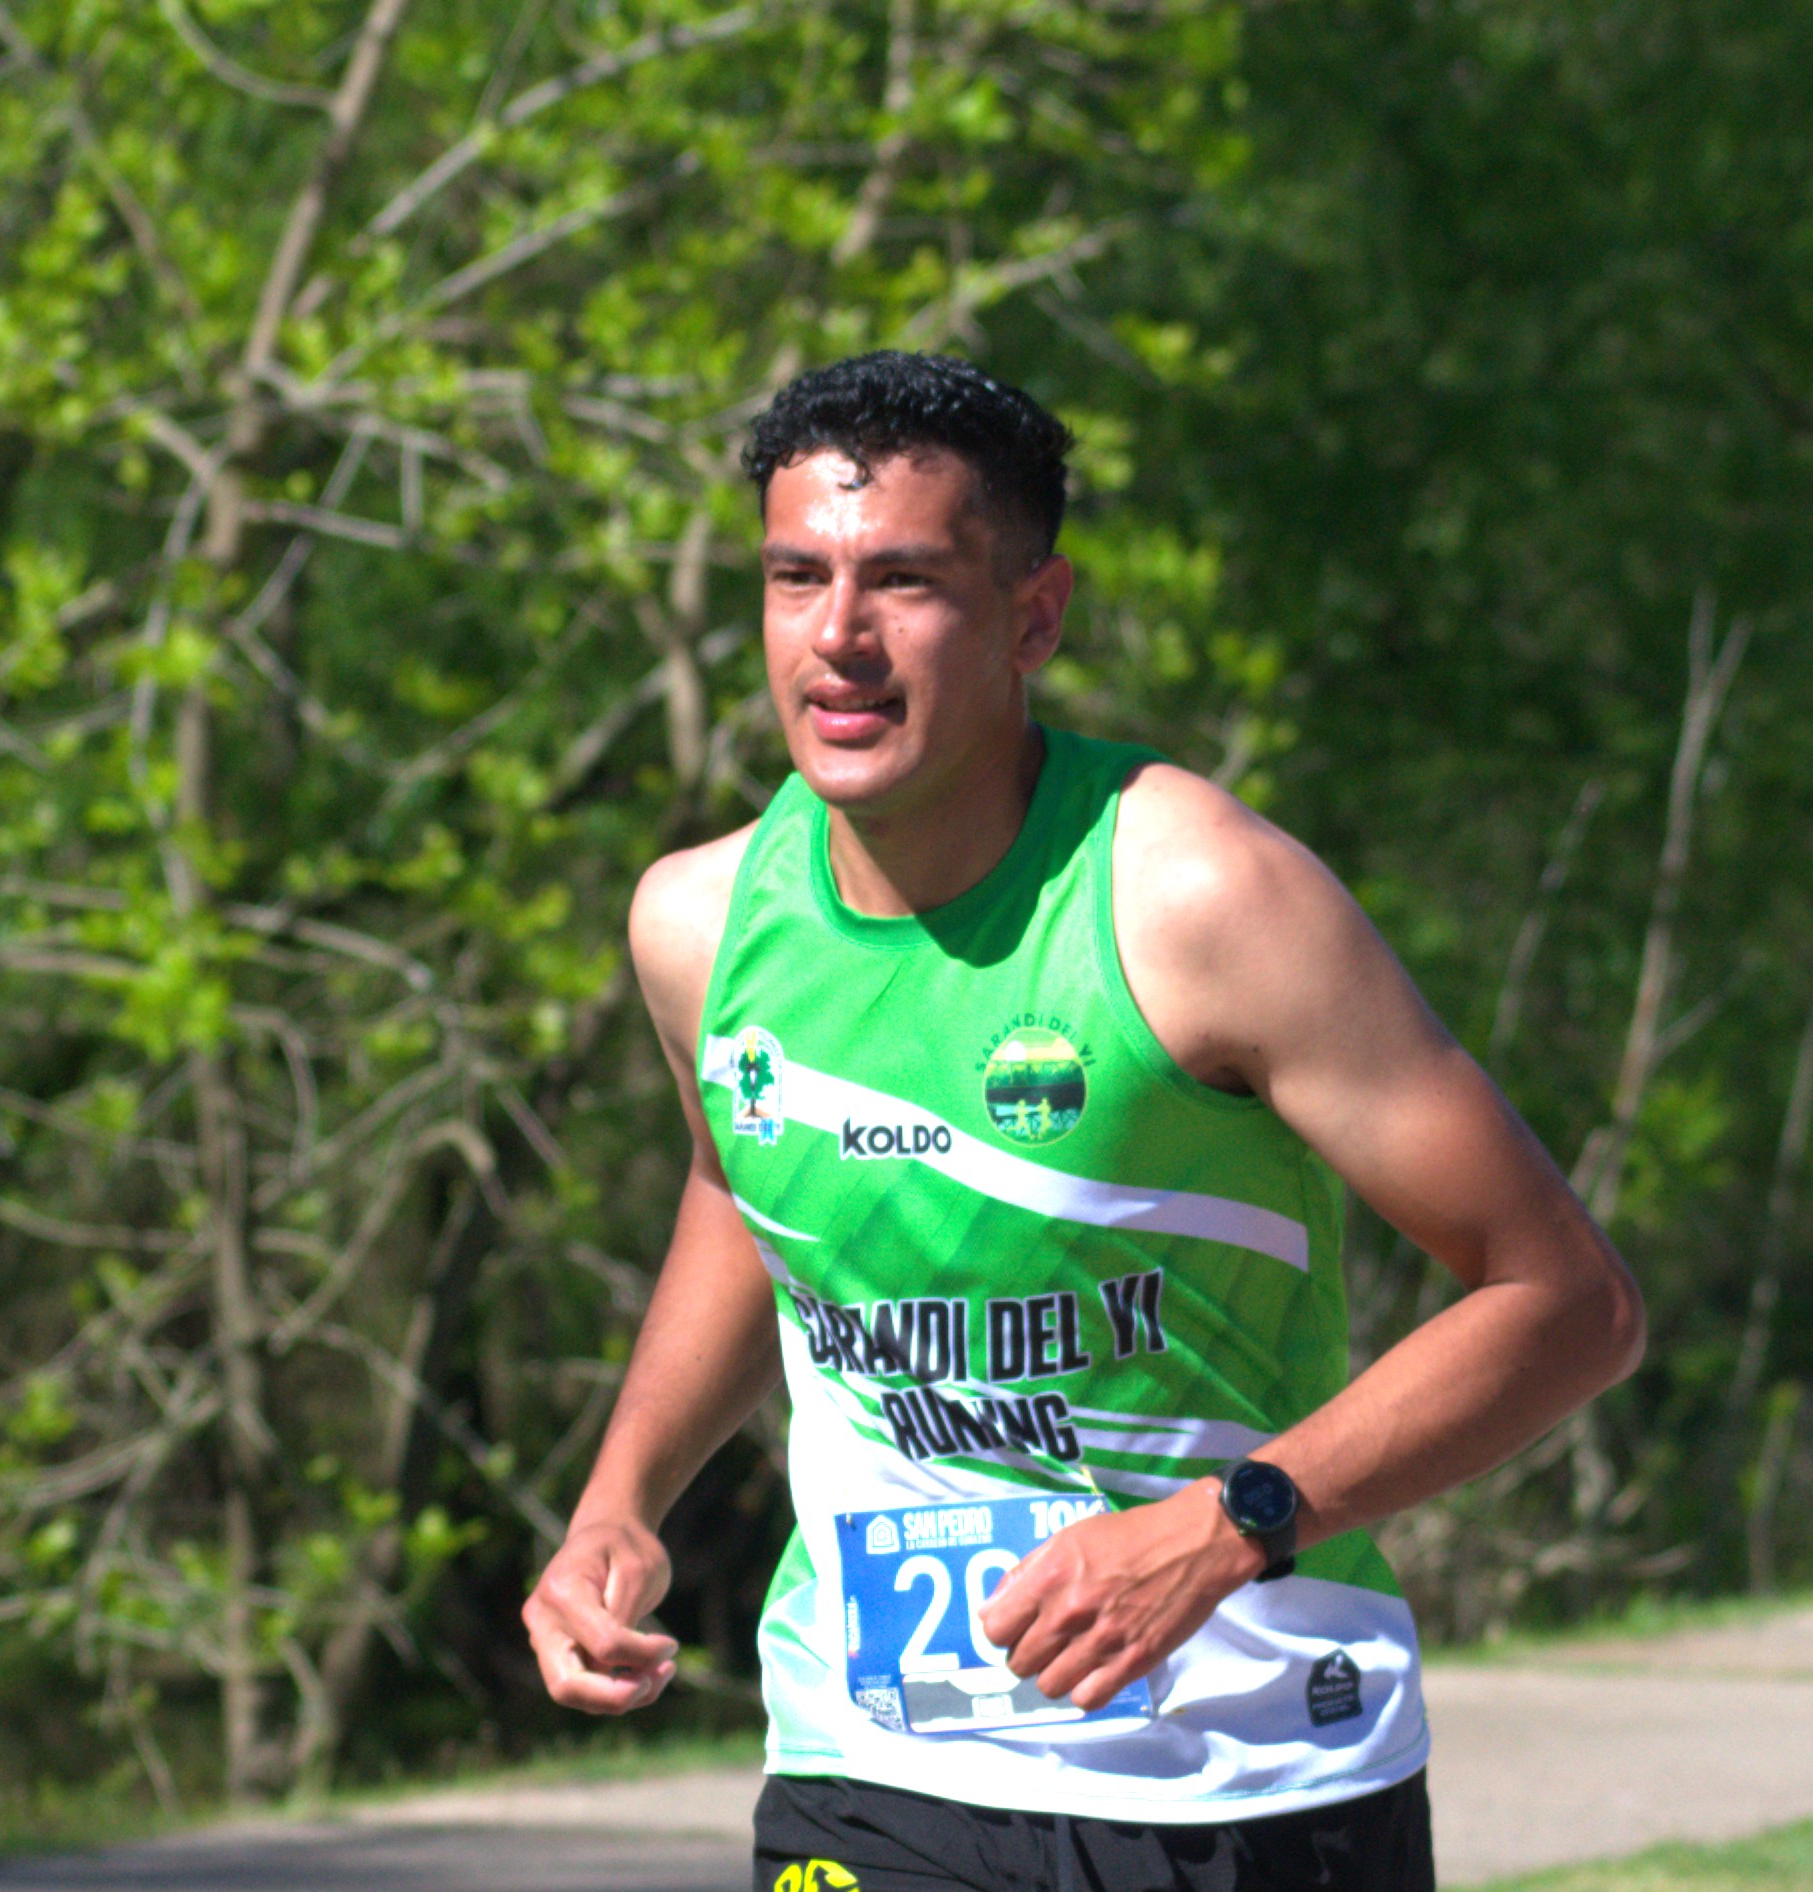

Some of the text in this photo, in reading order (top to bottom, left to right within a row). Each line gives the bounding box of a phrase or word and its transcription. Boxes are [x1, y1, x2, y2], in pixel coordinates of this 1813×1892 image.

[842, 1115, 952, 1156] KOLDO
[988, 1292, 1089, 1382] DEL
[1099, 1268, 1167, 1359] YI
[902, 1506, 993, 1541] SAN PEDRO
